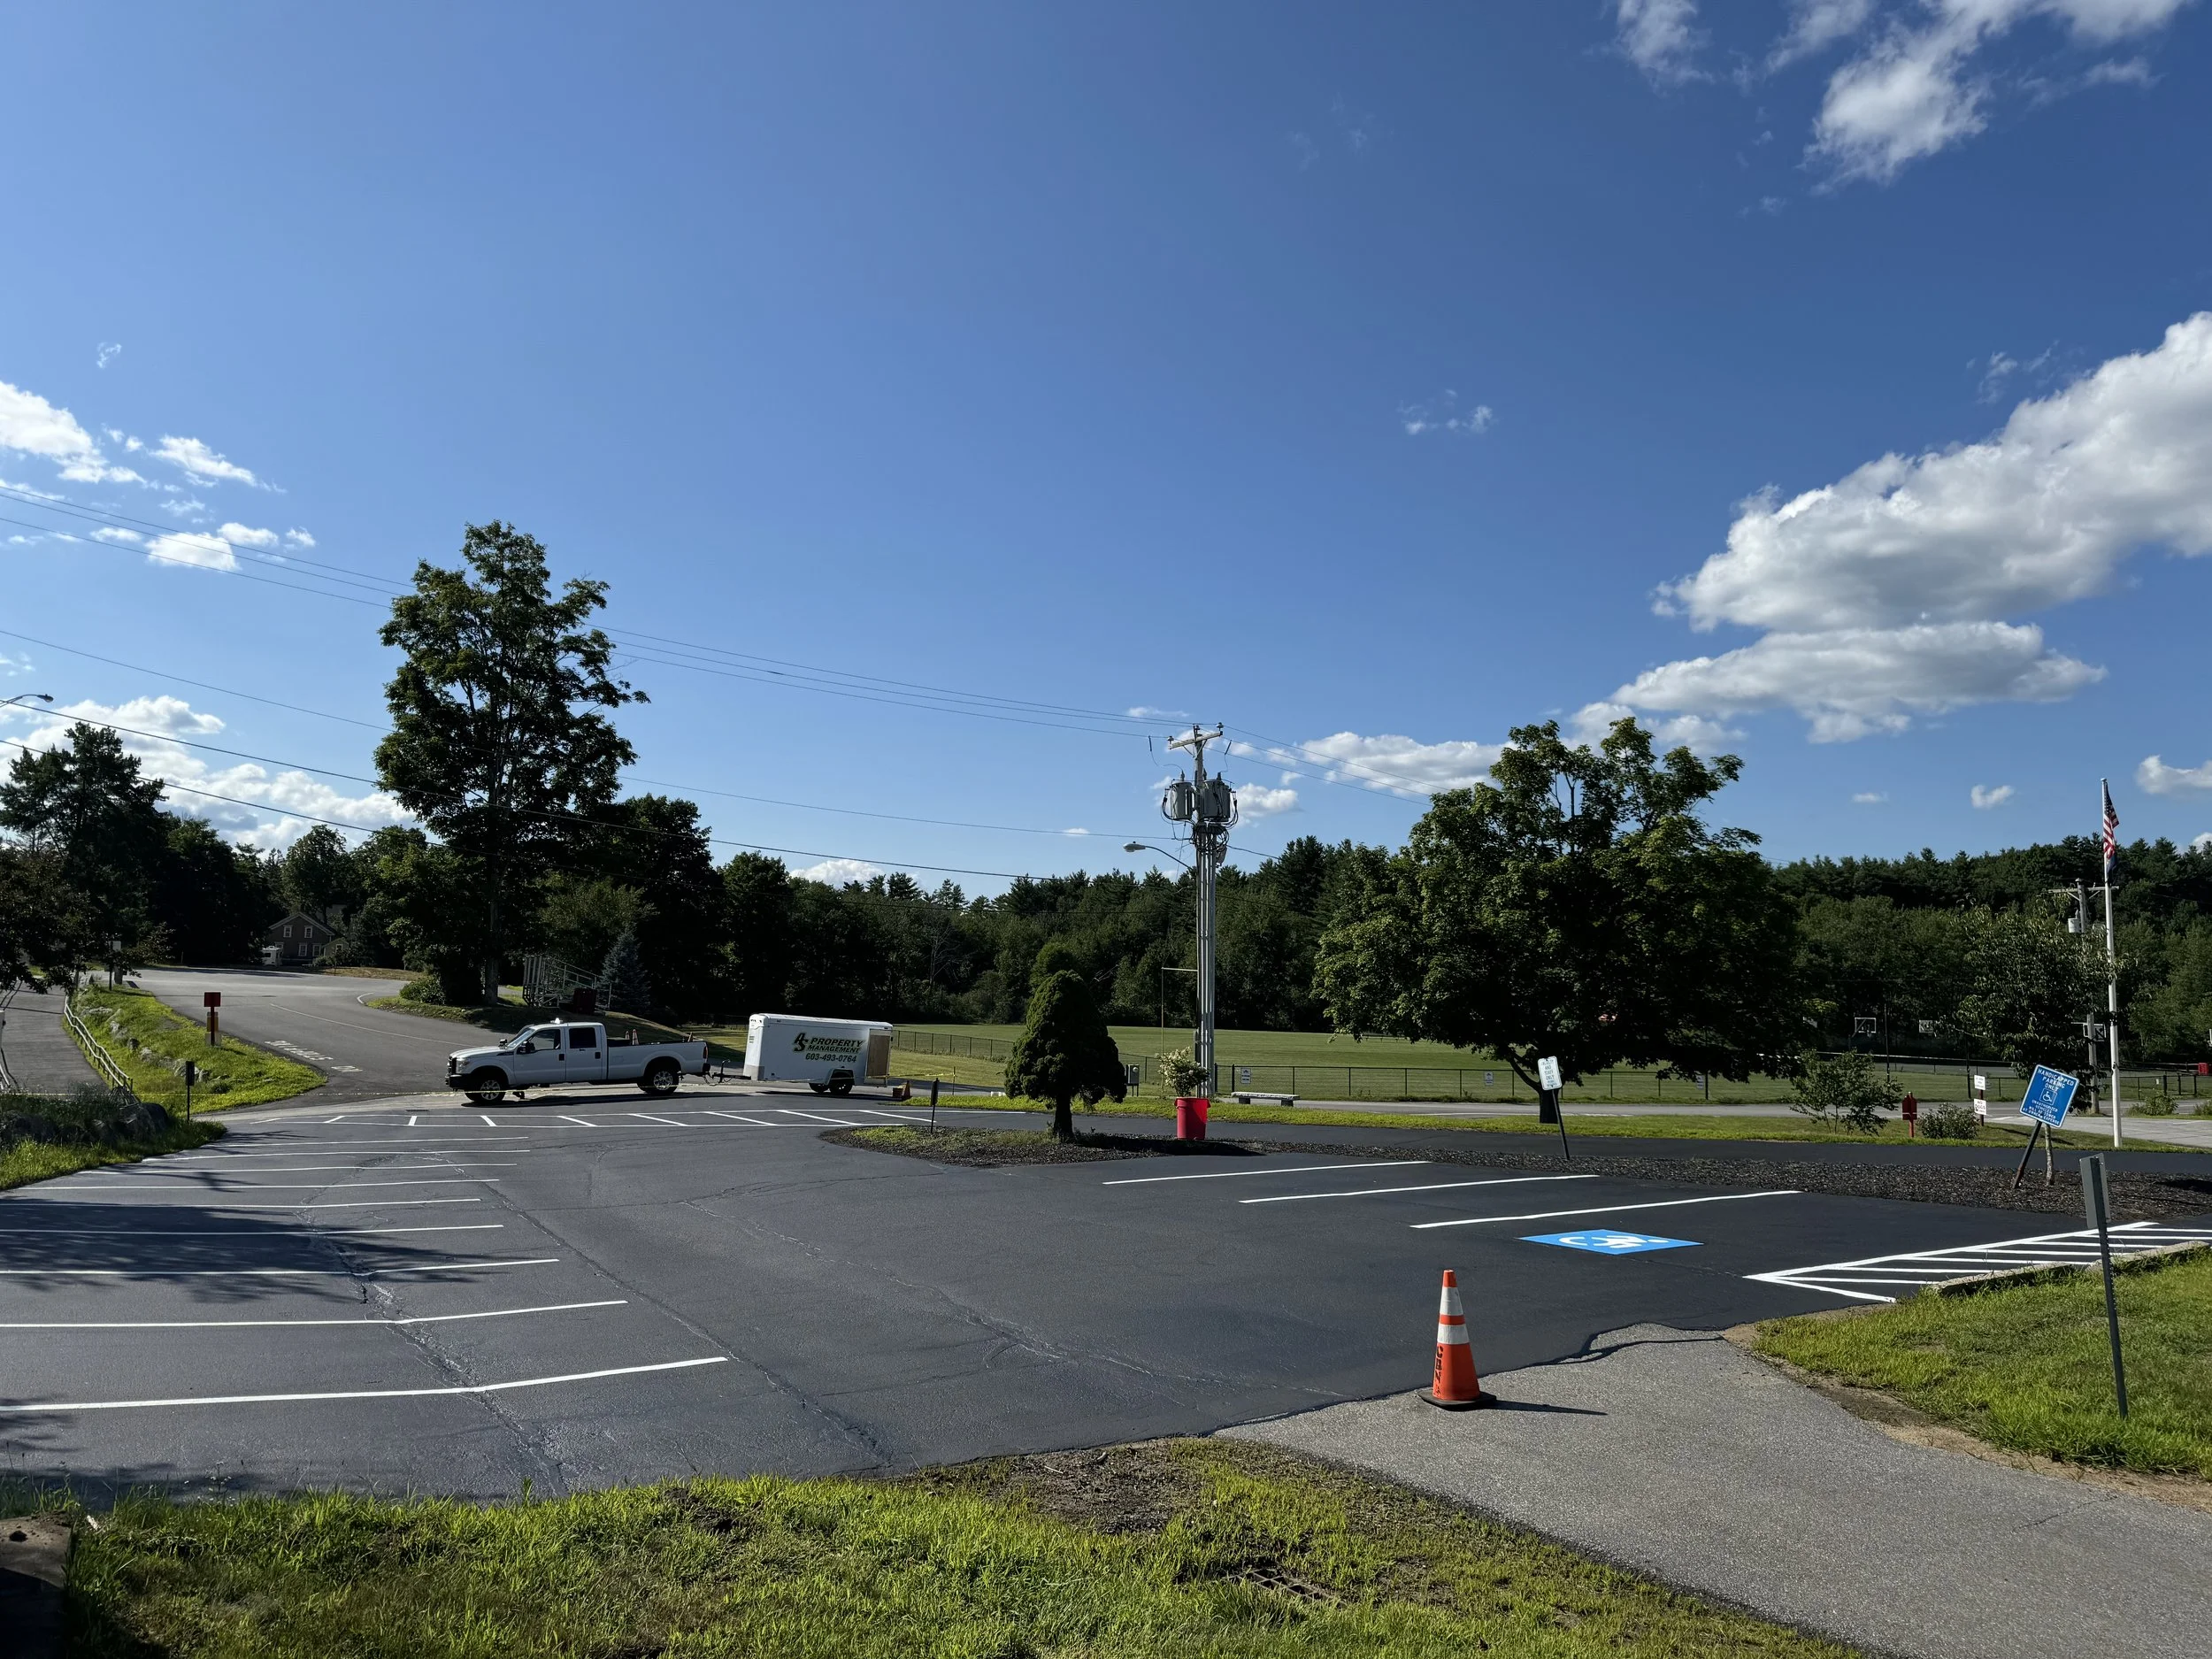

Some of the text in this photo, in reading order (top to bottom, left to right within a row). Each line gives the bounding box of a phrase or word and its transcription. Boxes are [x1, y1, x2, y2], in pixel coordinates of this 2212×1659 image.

[810, 1038, 863, 1048] PROPERTY
[805, 1053, 857, 1063] 603-493-0764
[2038, 1069, 2075, 1086] HANDICAPPED
[2042, 1077, 2065, 1088] PARKING
[2045, 1083, 2059, 1092] ONLY
[2032, 1100, 2058, 1112] UNAUTHORIZED
